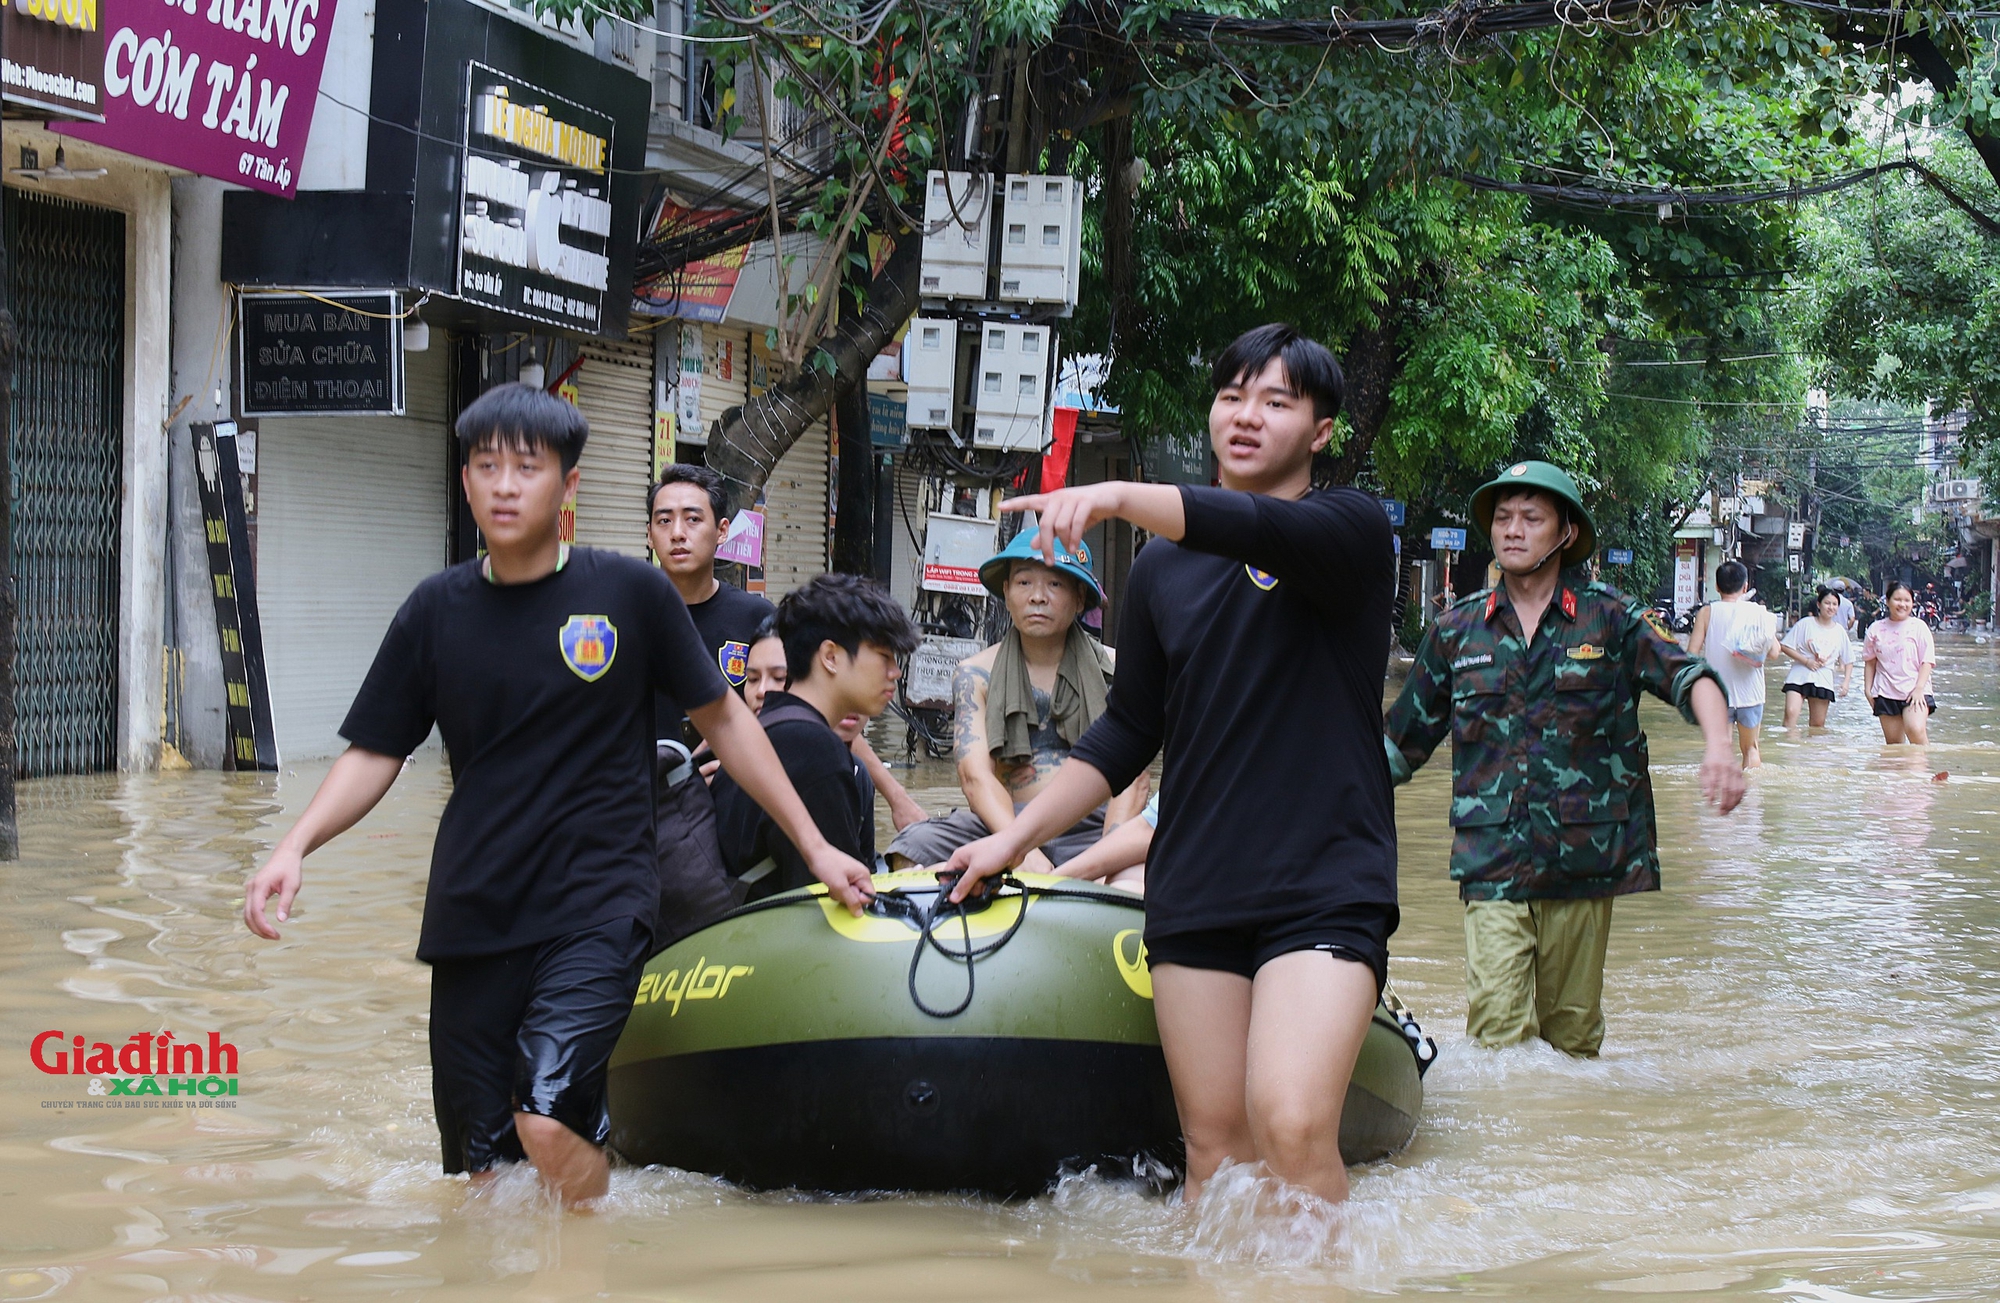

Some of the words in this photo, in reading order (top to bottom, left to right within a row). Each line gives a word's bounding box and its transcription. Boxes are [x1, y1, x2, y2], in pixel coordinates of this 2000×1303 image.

[104, 26, 200, 120] CƠM
[202, 53, 290, 149] TÁM
[485, 86, 509, 139] LÊ
[509, 104, 554, 158] NGHĨA
[556, 121, 607, 175] MOBILE
[239, 151, 255, 176] 67
[255, 156, 275, 183] Tân
[274, 156, 291, 191] Ấp
[263, 313, 317, 333] MUA
[323, 310, 371, 332] BÁN
[258, 338, 307, 366] SỬA
[312, 340, 377, 365] CHỮA
[254, 375, 308, 404] ĐIỆN
[313, 379, 384, 403] THOẠI
[660, 418, 670, 440] 71
[1385, 504, 1395, 512] 75
[952, 569, 973, 578] TRONG
[633, 956, 749, 1017] evylor
